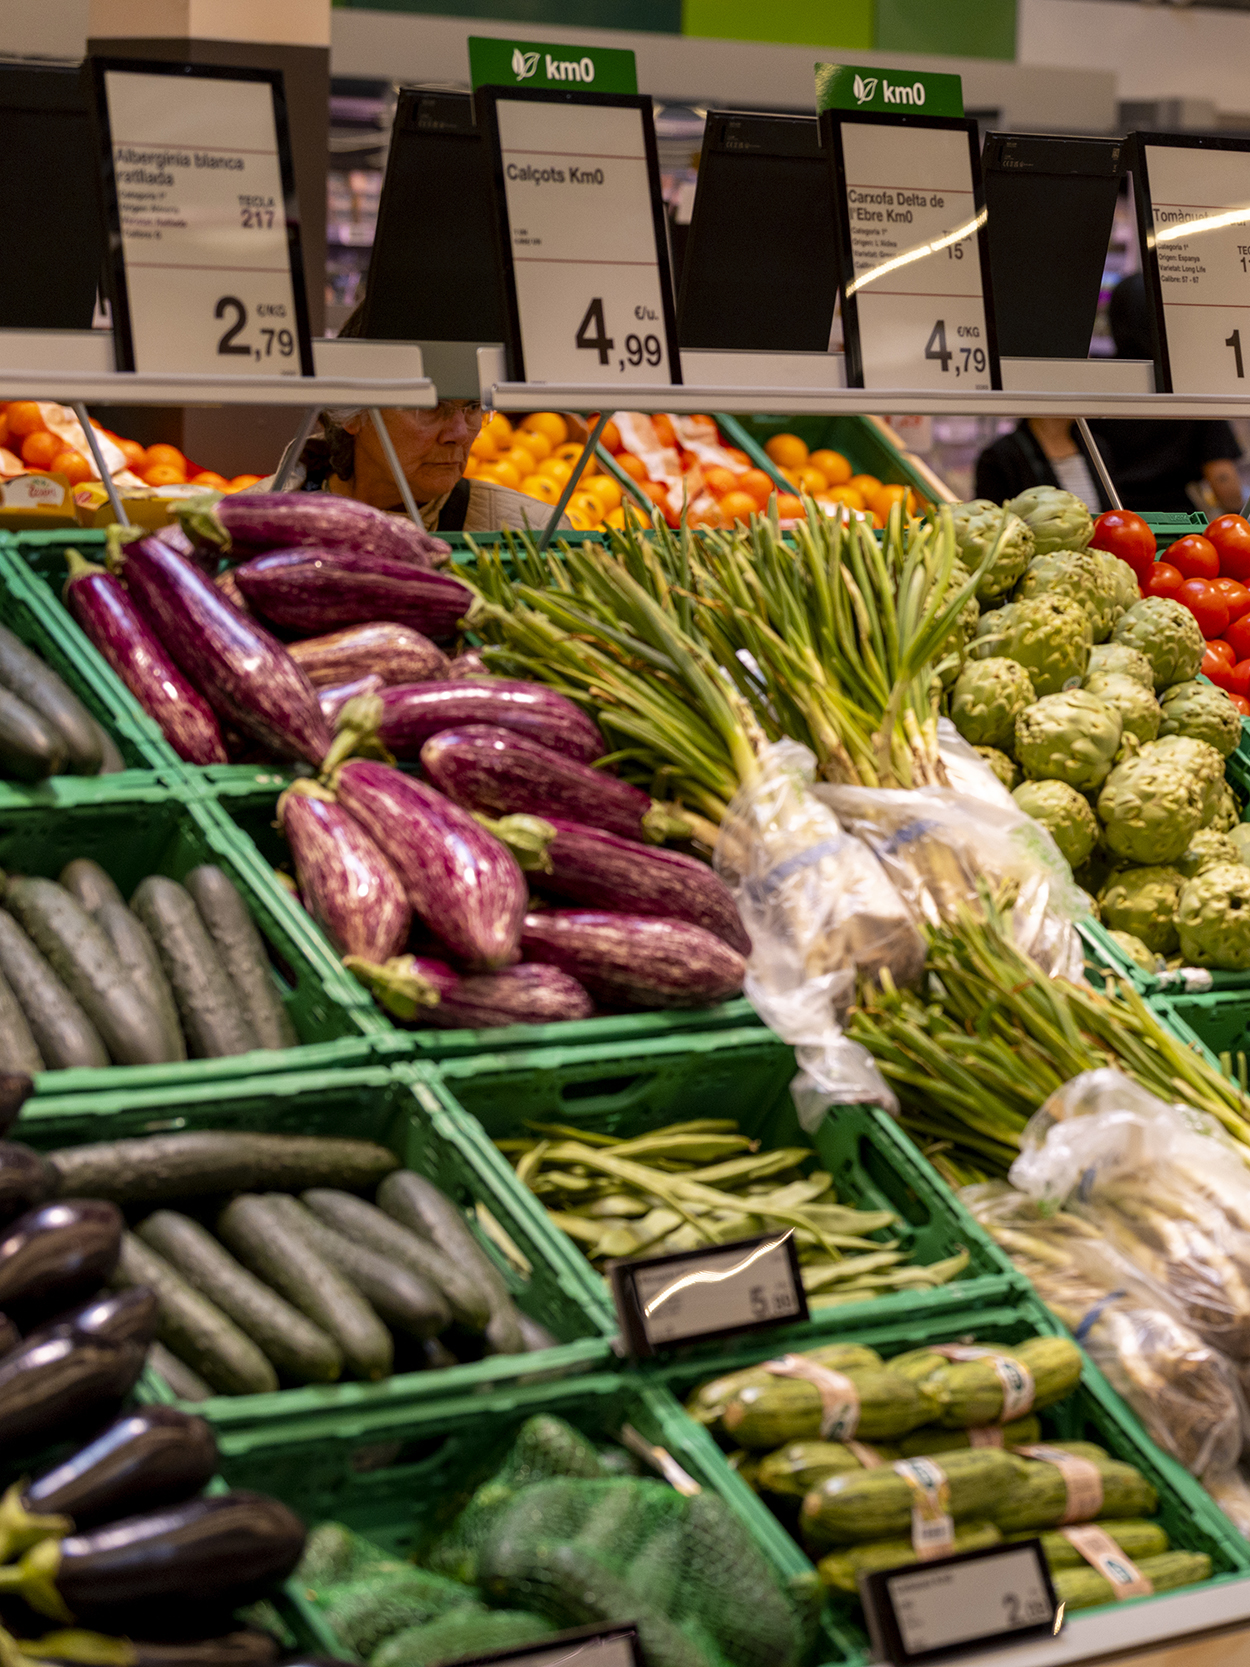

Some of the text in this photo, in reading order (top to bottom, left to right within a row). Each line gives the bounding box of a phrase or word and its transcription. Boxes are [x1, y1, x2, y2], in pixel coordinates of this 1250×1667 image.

[545, 54, 596, 83] km0
[882, 79, 926, 106] km0
[506, 163, 605, 186] Calçots Km0
[848, 189, 944, 208] Carxofa Delta de
[240, 209, 275, 229] 217
[886, 208, 913, 224] Km0
[1178, 254, 1200, 263] Espanya
[214, 295, 294, 361] 2,79
[575, 297, 662, 372] 4,99
[957, 326, 980, 338] €/KG
[924, 320, 986, 377] 4,79
